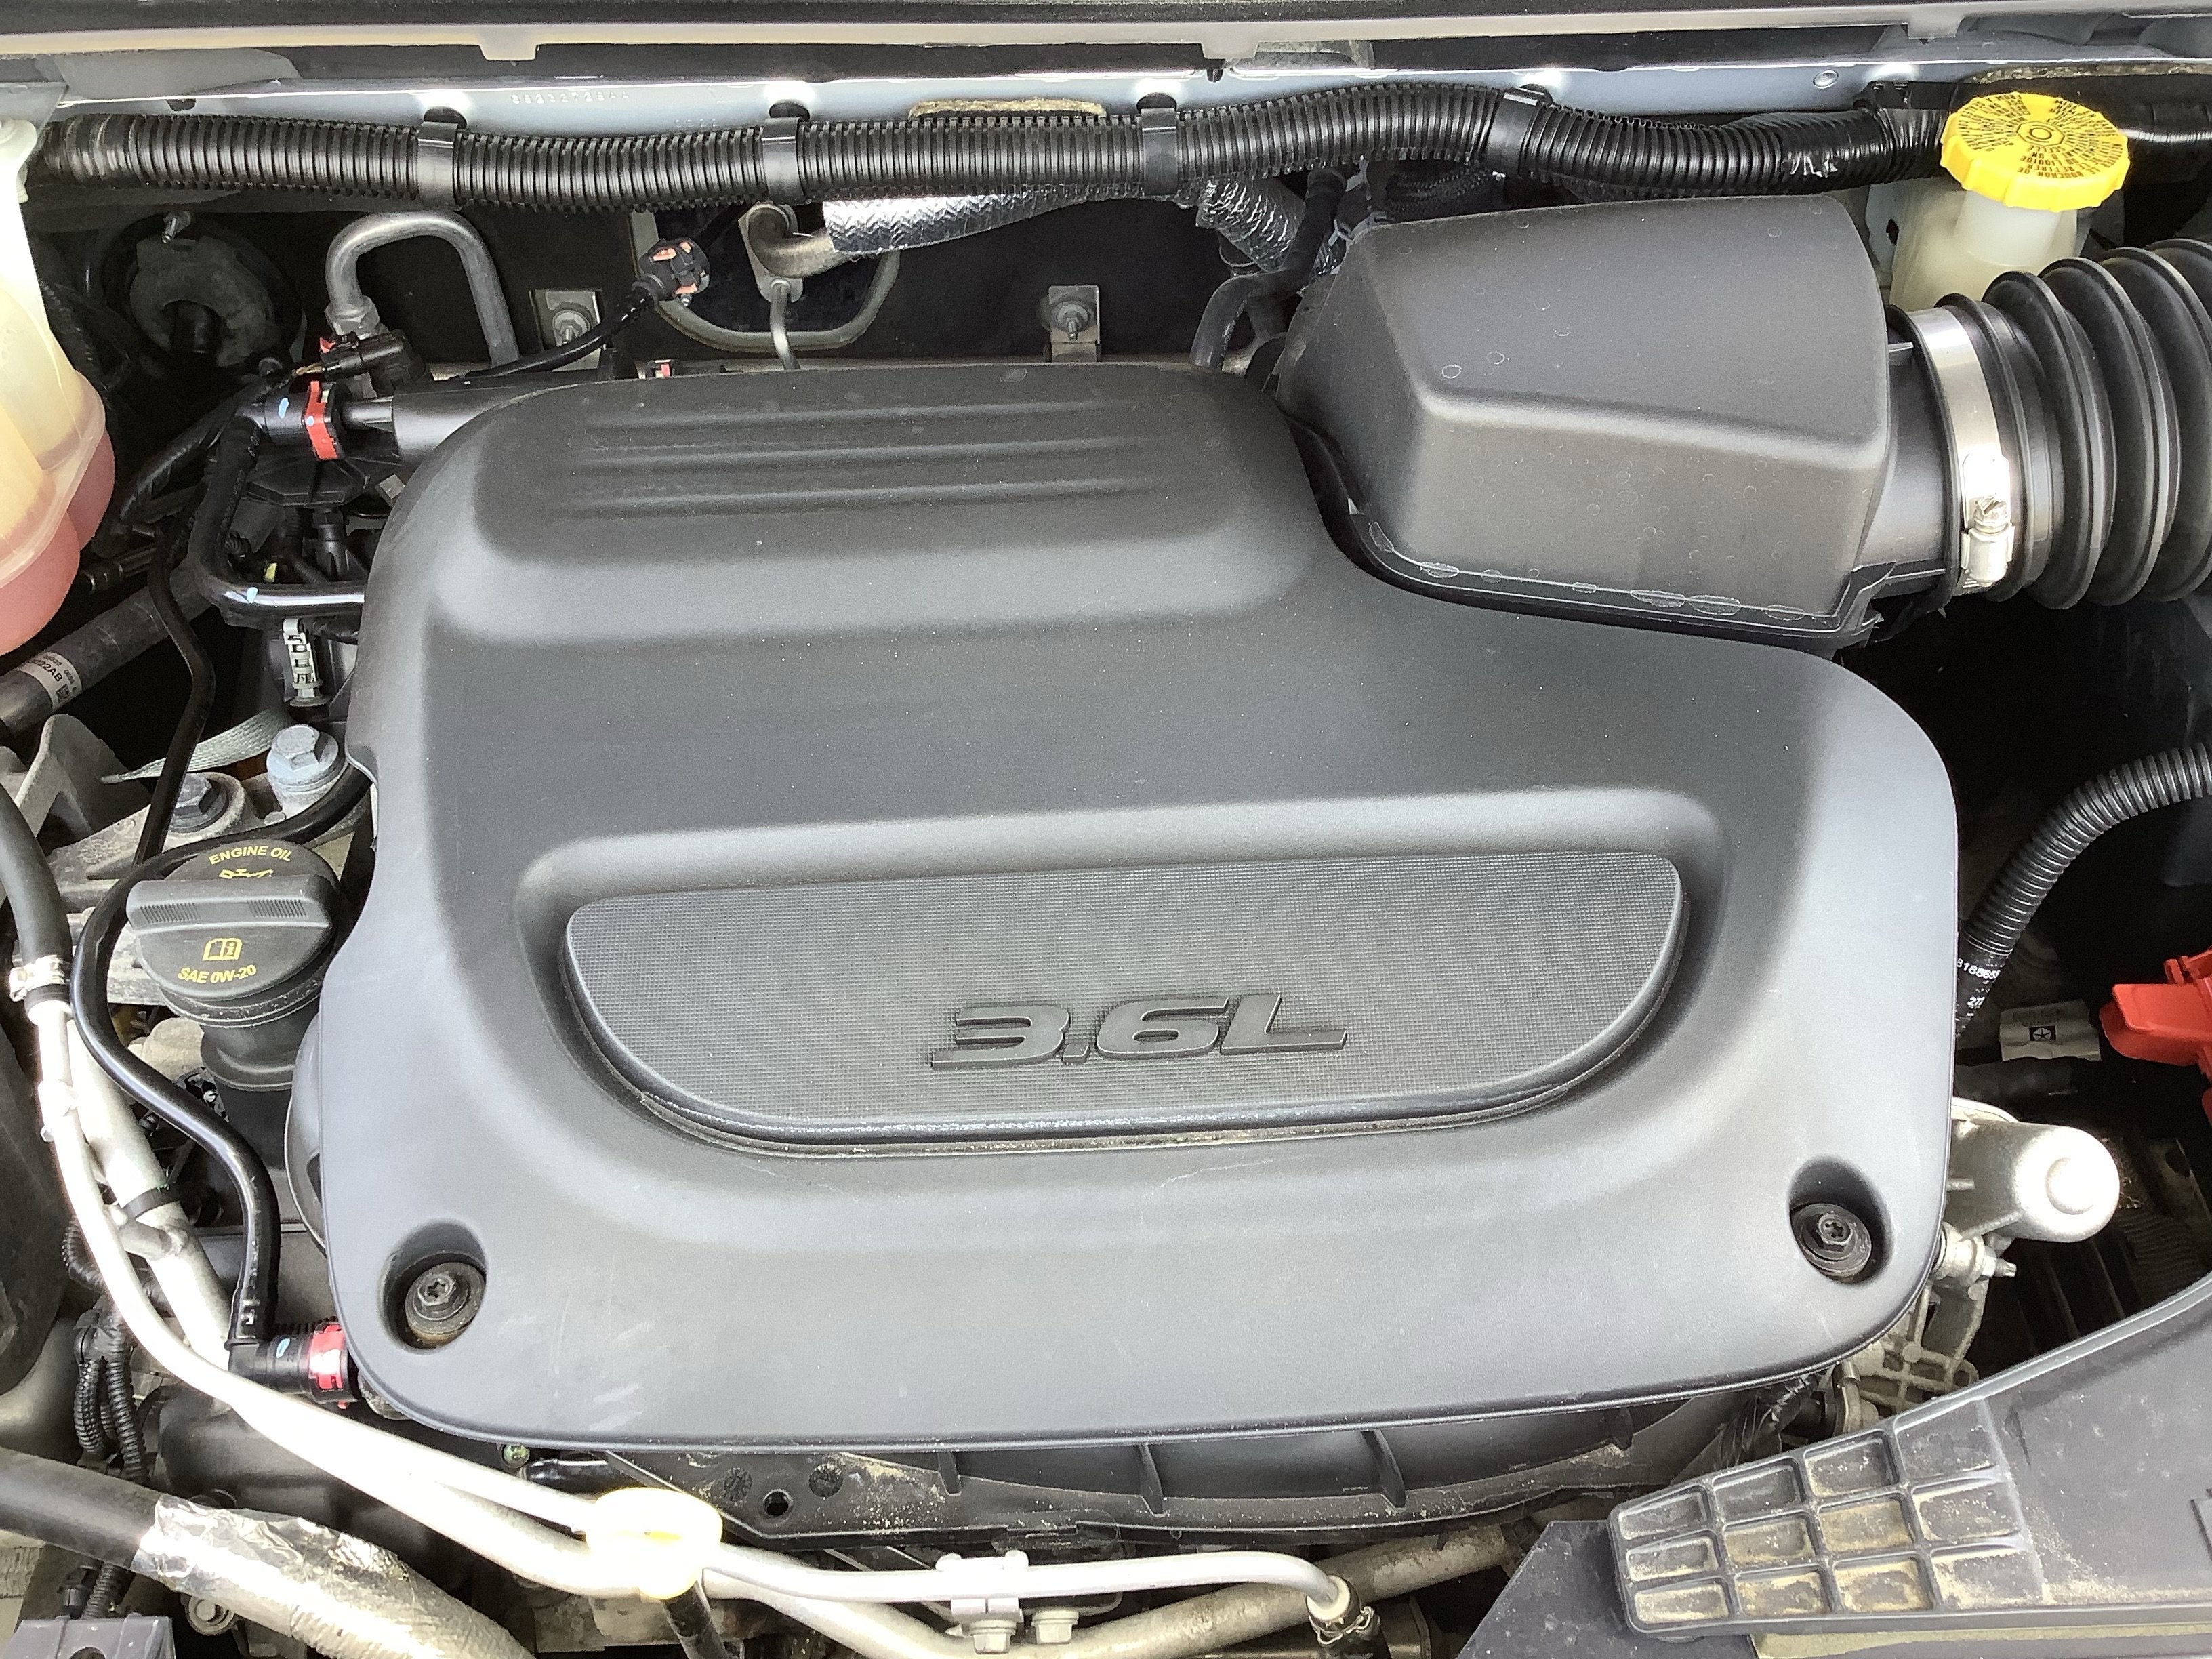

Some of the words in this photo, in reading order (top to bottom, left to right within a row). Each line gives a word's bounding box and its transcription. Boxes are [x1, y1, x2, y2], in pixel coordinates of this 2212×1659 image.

[209, 846, 266, 865] ENGINE
[271, 847, 292, 861] OIL
[178, 967, 209, 983] SAE
[211, 964, 257, 983] 0W-20
[930, 993, 1348, 1069] 3.6L
